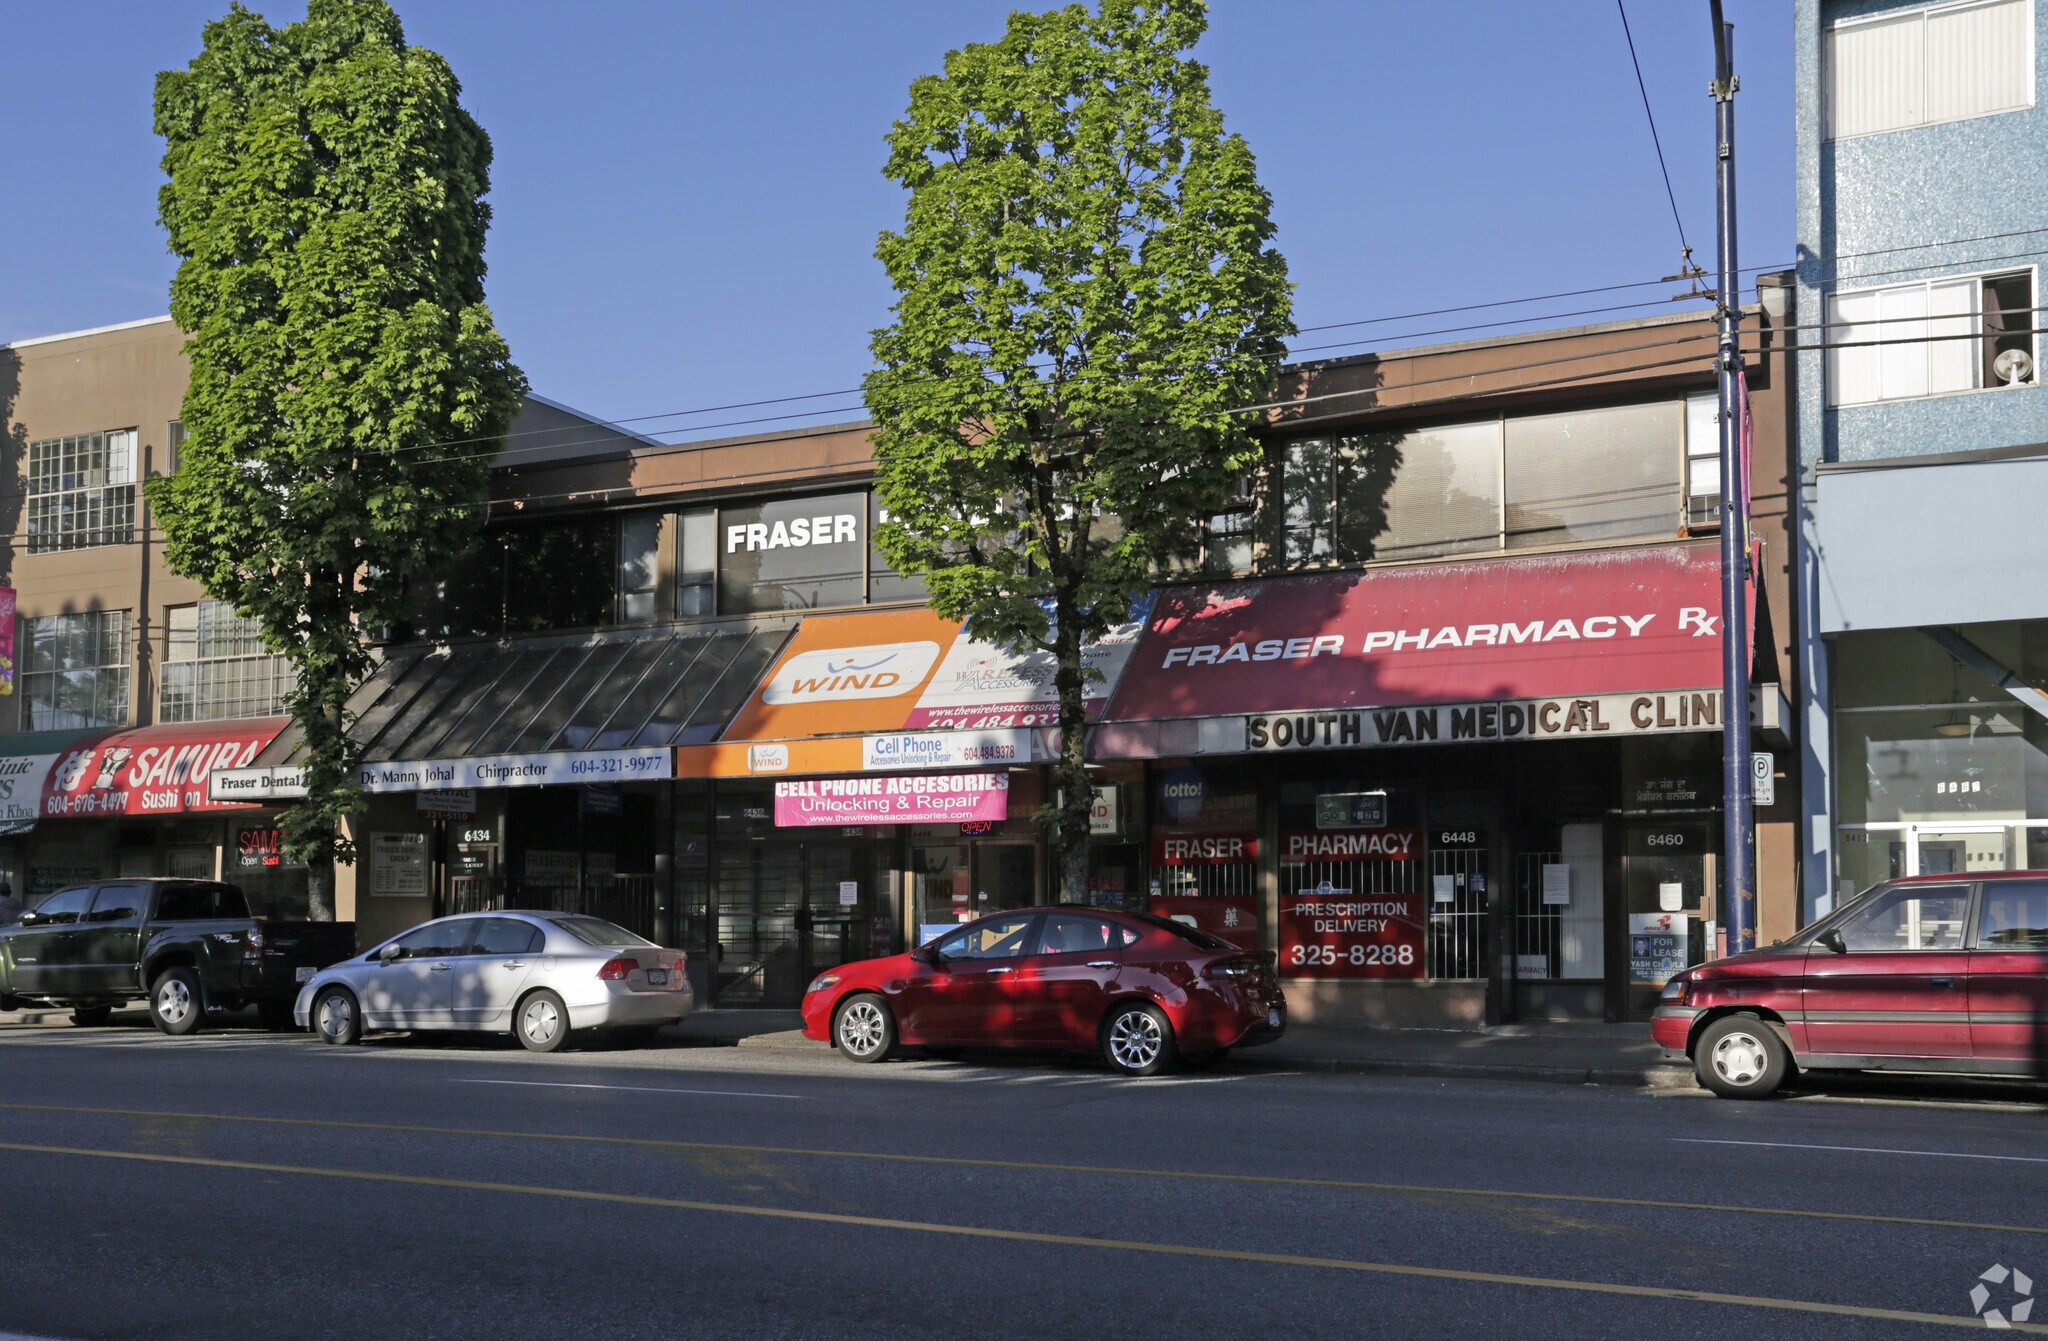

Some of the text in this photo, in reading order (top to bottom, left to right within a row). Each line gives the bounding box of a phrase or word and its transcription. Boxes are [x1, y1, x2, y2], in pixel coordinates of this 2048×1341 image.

[727, 514, 856, 553] FRASER
[1161, 613, 1657, 669] FRASER PHARMACY
[791, 671, 900, 694] WIND
[1250, 713, 1360, 748] SOUTH
[1373, 709, 1438, 742] VAN
[1451, 700, 1610, 739] MEDICAL
[876, 737, 942, 753] Cell Phone
[901, 753, 928, 766] Unlocking
[934, 752, 950, 764] Repair
[964, 746, 1015, 761] 604.484.9378
[129, 739, 273, 787] SAMURA
[571, 756, 662, 775] 604-321-9977
[752, 756, 783, 767] WIND
[1758, 762, 1766, 774] P
[361, 766, 454, 786] Dr. Manny Johal
[476, 764, 548, 782] Chirpractor
[221, 775, 300, 789] Fraser Dental
[776, 773, 1009, 798] CELL PHONE ACCESORIES
[48, 790, 128, 814] 604-676-4479
[142, 789, 178, 809] Sushi
[185, 791, 200, 806] on
[801, 794, 980, 813] Unlocking & Repair
[7, 804, 34, 818] Khoa
[810, 811, 972, 822] www.thewirelessaccessories.com
[961, 821, 992, 832] OPEN
[464, 830, 490, 842] 6434
[1442, 832, 1476, 844] 6448
[1648, 834, 1684, 846] 6460
[1164, 838, 1242, 860] FRASER
[1290, 833, 1412, 856] PHARMACY
[242, 856, 258, 866] Open
[1296, 902, 1408, 917] PRESCRIPTION
[1314, 919, 1388, 933] DELIVERY
[1654, 938, 1672, 946] FOR
[1291, 944, 1414, 966] 325-8288
[1654, 948, 1684, 957] LEASE
